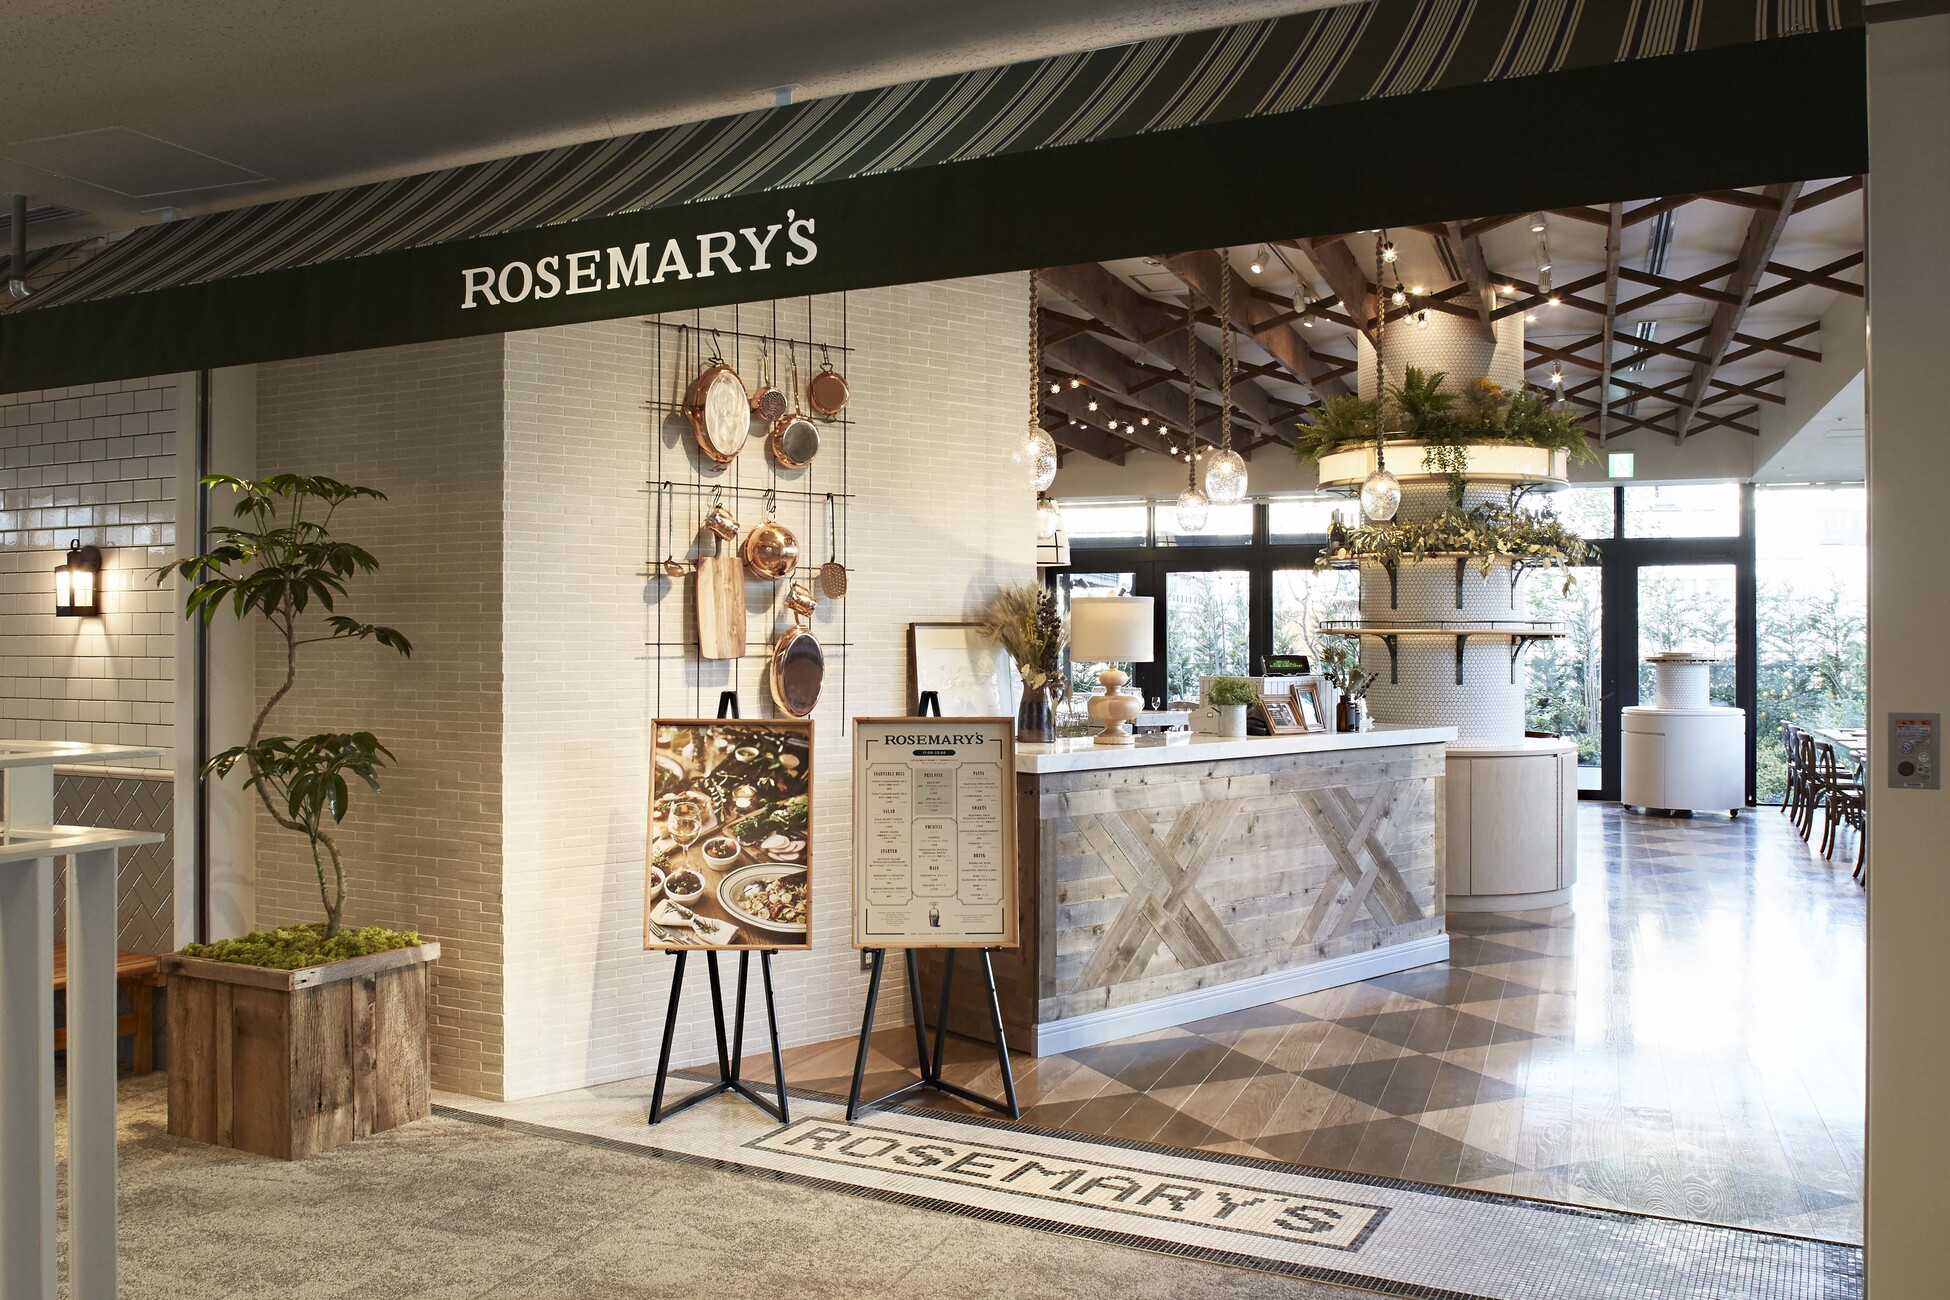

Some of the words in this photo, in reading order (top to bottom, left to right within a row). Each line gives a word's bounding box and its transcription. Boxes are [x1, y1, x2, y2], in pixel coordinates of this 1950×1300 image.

[461, 208, 818, 309] ROSEMARY'S
[884, 732, 984, 745] ROSEMARY'S
[784, 1126, 1344, 1234] ROSEMARY'S
